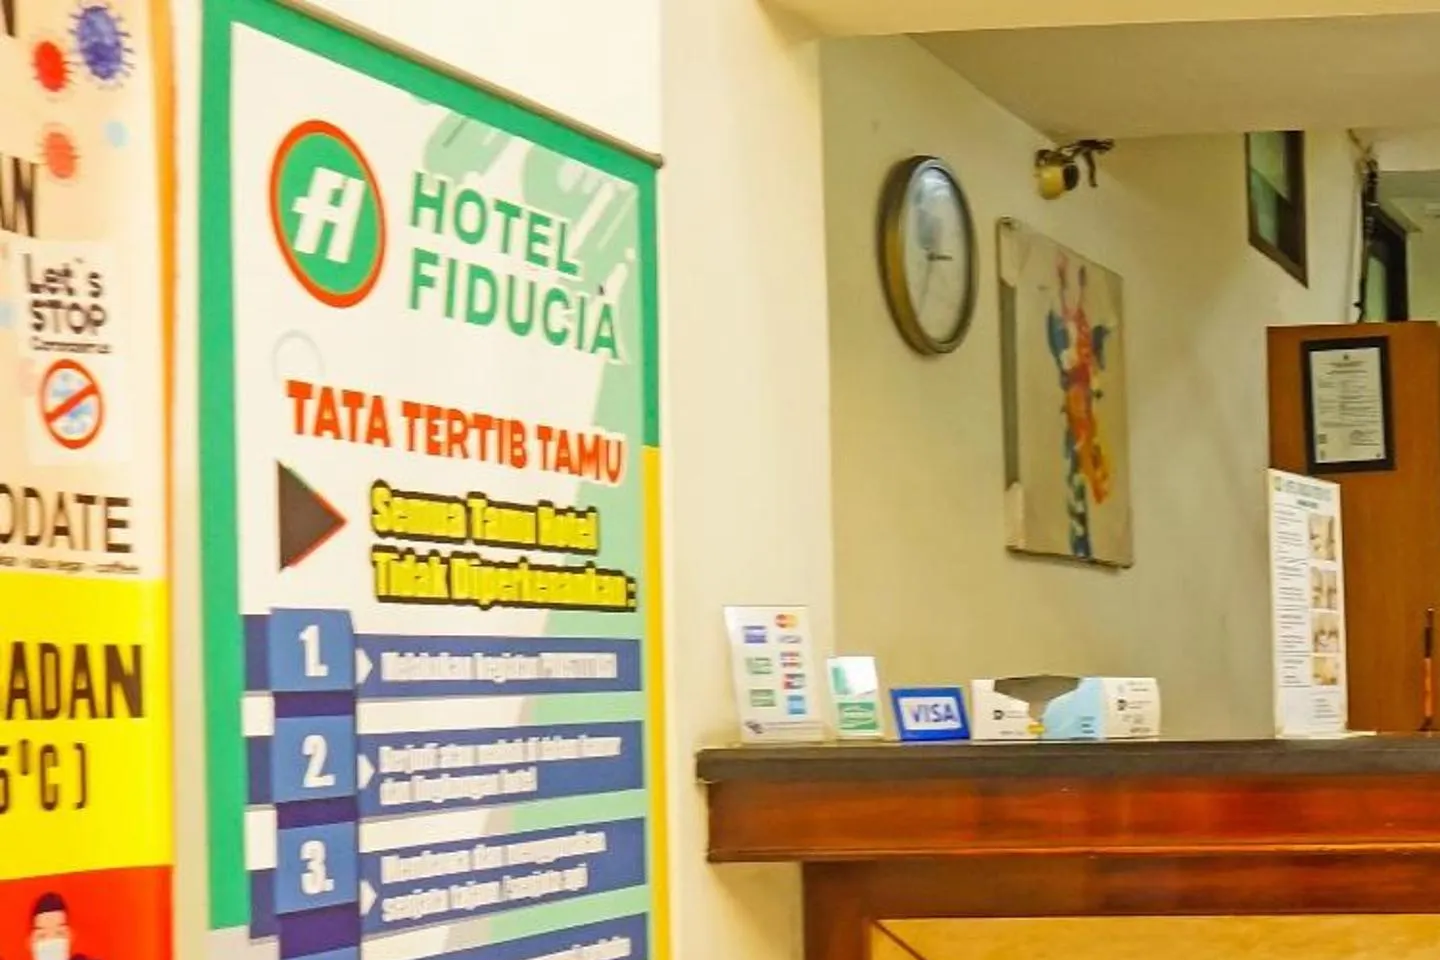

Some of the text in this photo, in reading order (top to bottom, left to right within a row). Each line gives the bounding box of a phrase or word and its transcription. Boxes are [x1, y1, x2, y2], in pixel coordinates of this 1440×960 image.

[410, 171, 581, 276] HOTEL
[31, 300, 107, 335] STOP
[410, 247, 620, 360] FIDUCIA
[287, 379, 626, 483] TATA TERTIB TAMU
[298, 624, 330, 677] 1.
[910, 702, 958, 724] VISA
[301, 840, 335, 894] 3.
